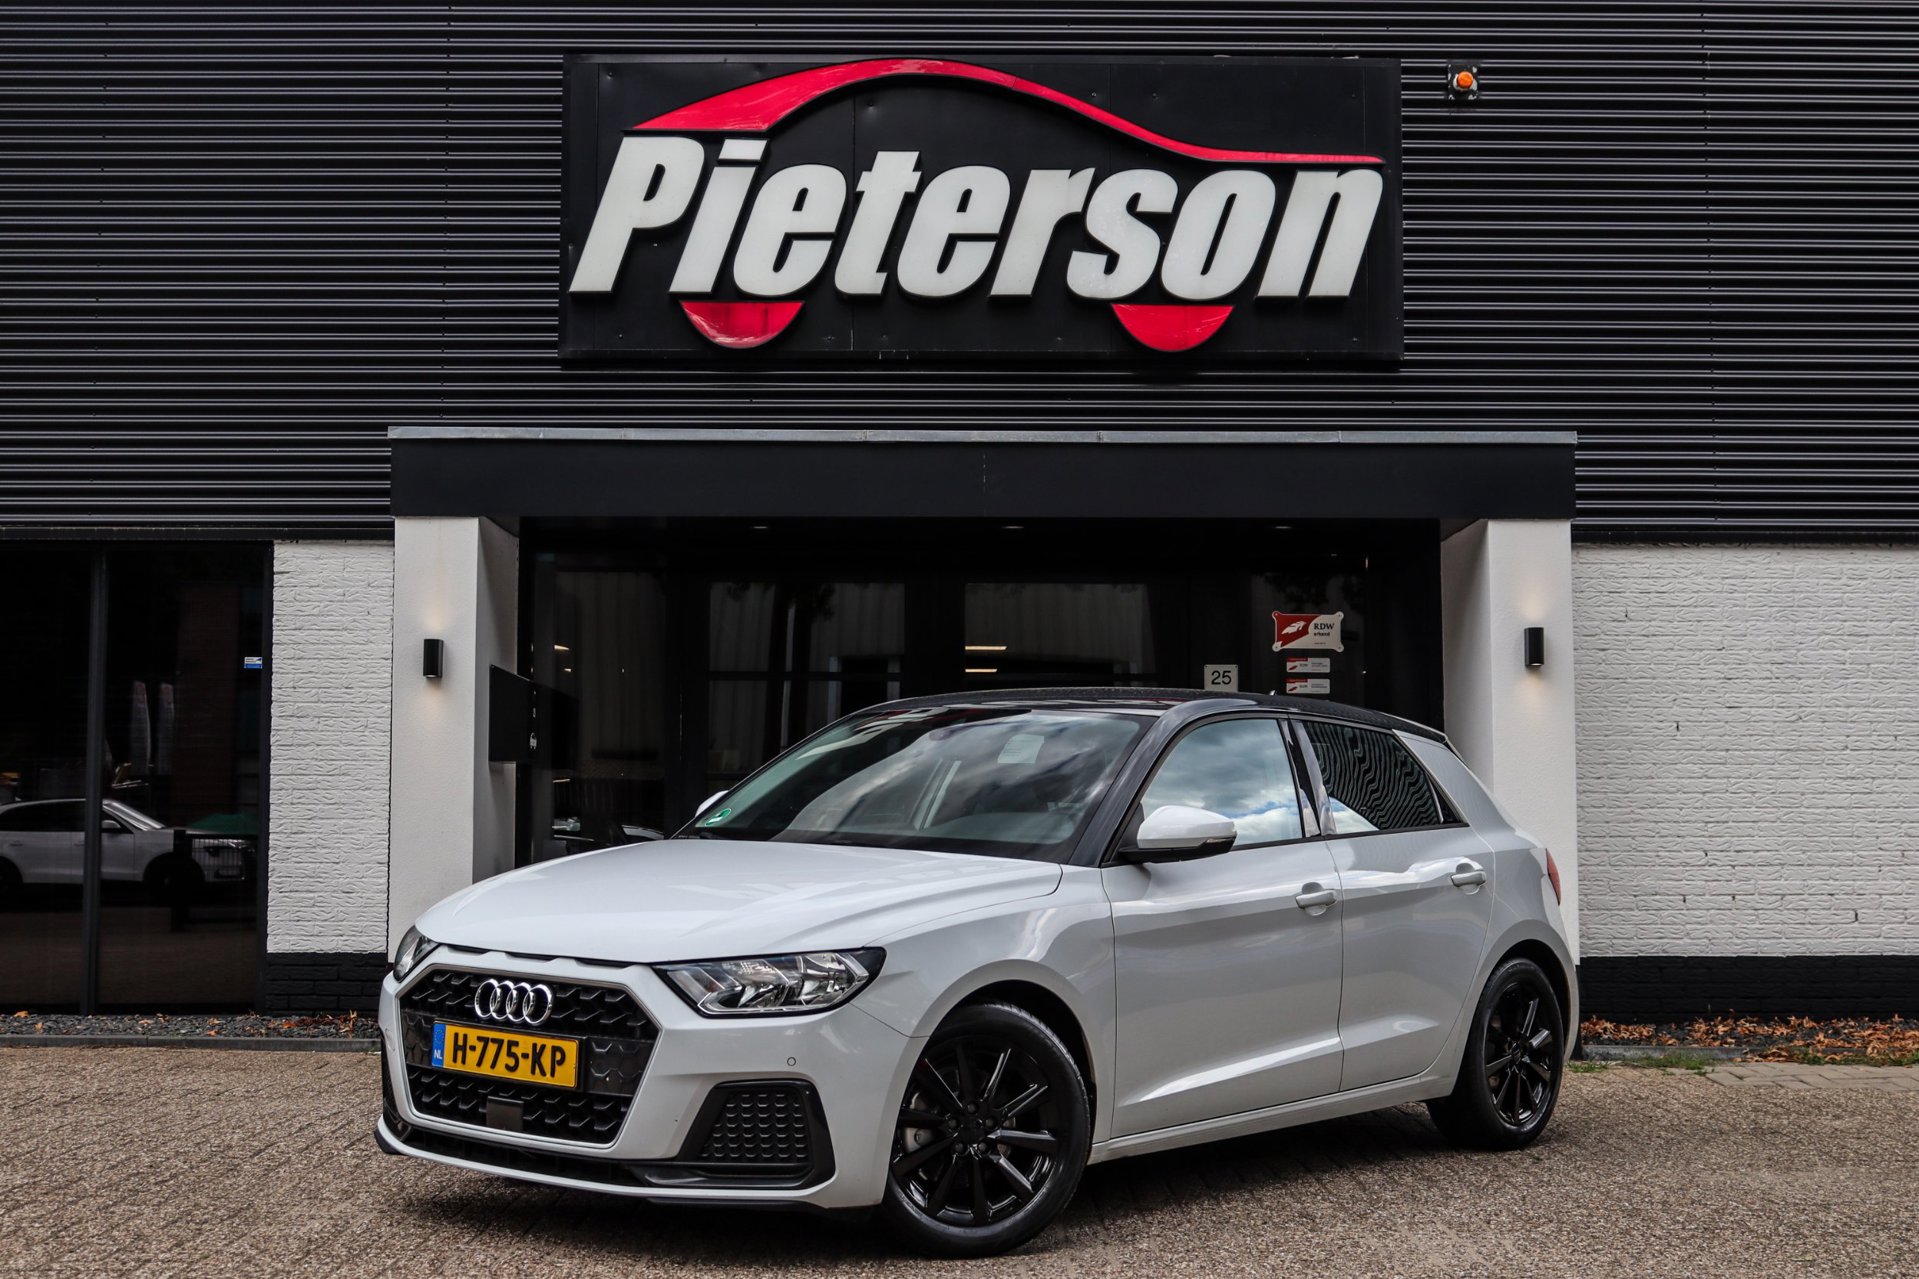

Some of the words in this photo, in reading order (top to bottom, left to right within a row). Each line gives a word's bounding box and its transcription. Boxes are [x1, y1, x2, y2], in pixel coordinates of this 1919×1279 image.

[569, 136, 1384, 300] Pieterson
[1211, 670, 1232, 685] 25
[433, 1049, 443, 1060] NL
[452, 1032, 567, 1077] H-775-KP
